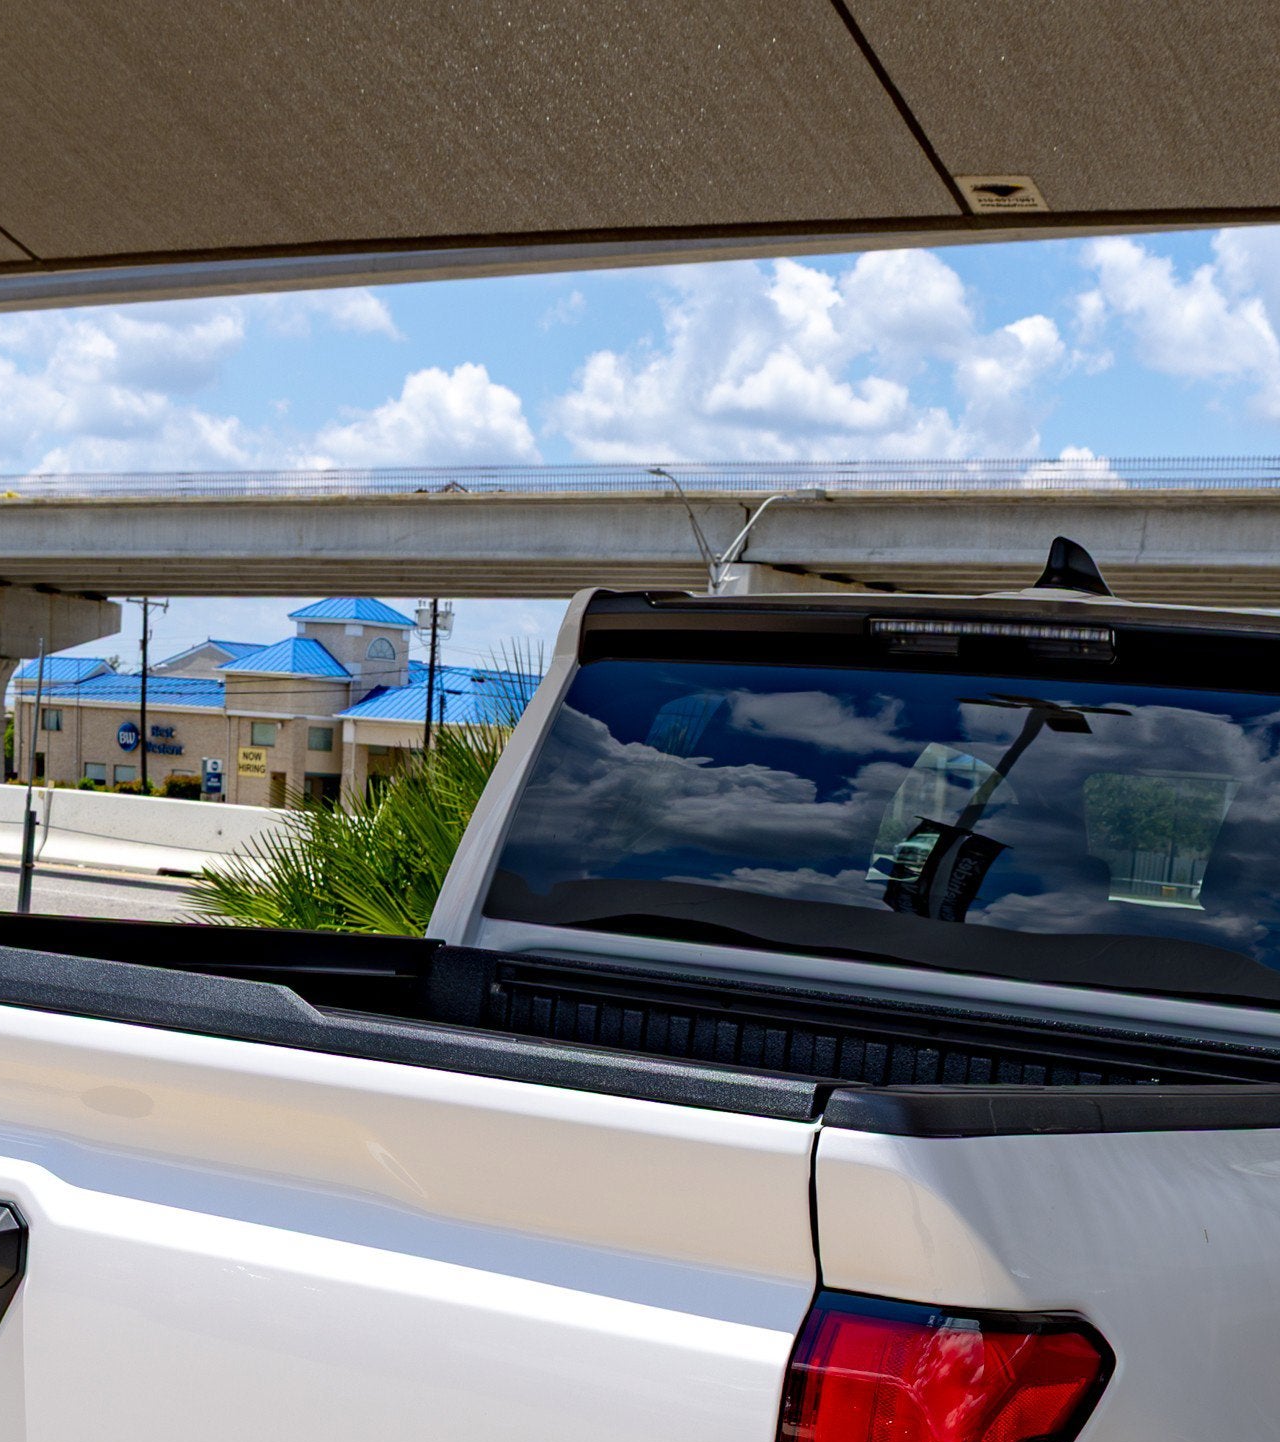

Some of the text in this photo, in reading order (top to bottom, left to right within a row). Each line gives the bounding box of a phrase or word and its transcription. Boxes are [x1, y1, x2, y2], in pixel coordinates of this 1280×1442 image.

[119, 731, 136, 745] BW
[242, 751, 262, 762] NOW
[238, 764, 266, 775] HIRING
